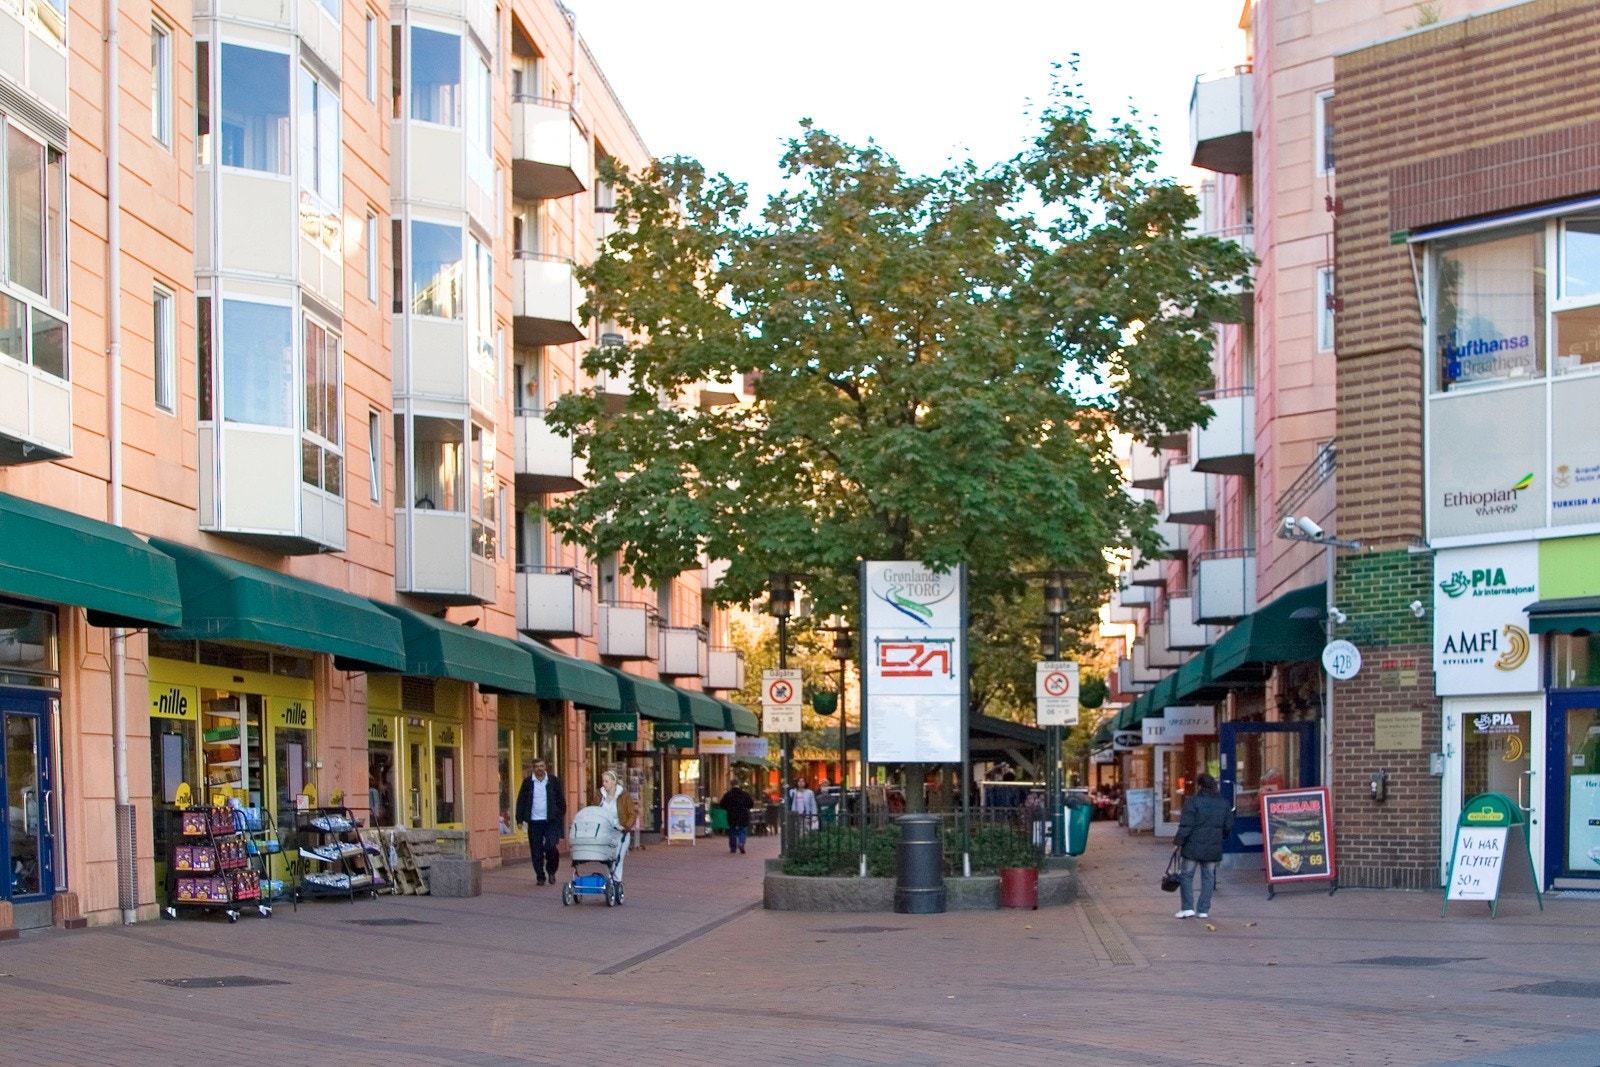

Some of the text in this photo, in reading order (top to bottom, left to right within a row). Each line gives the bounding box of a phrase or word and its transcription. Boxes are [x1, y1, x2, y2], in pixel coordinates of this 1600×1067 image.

[1447, 335, 1529, 360] Lufthansa
[1444, 488, 1517, 507] Ethiopian
[1552, 499, 1588, 508] TURKISH
[883, 568, 940, 582] Grønlands
[1472, 567, 1507, 587] PIA
[906, 583, 940, 597] TORG
[1472, 589, 1484, 597] Air
[1443, 629, 1498, 654] AMFI
[1333, 654, 1352, 675] 42B
[1492, 713, 1514, 726] PIA
[594, 722, 634, 734] NOTABENE
[656, 731, 691, 742] NOTABENE
[1270, 801, 1320, 814] KEBAB
[1308, 831, 1321, 843] 45
[1479, 839, 1499, 850] HAR
[1309, 854, 1323, 866] 69
[1460, 855, 1500, 868] FLYTTET
